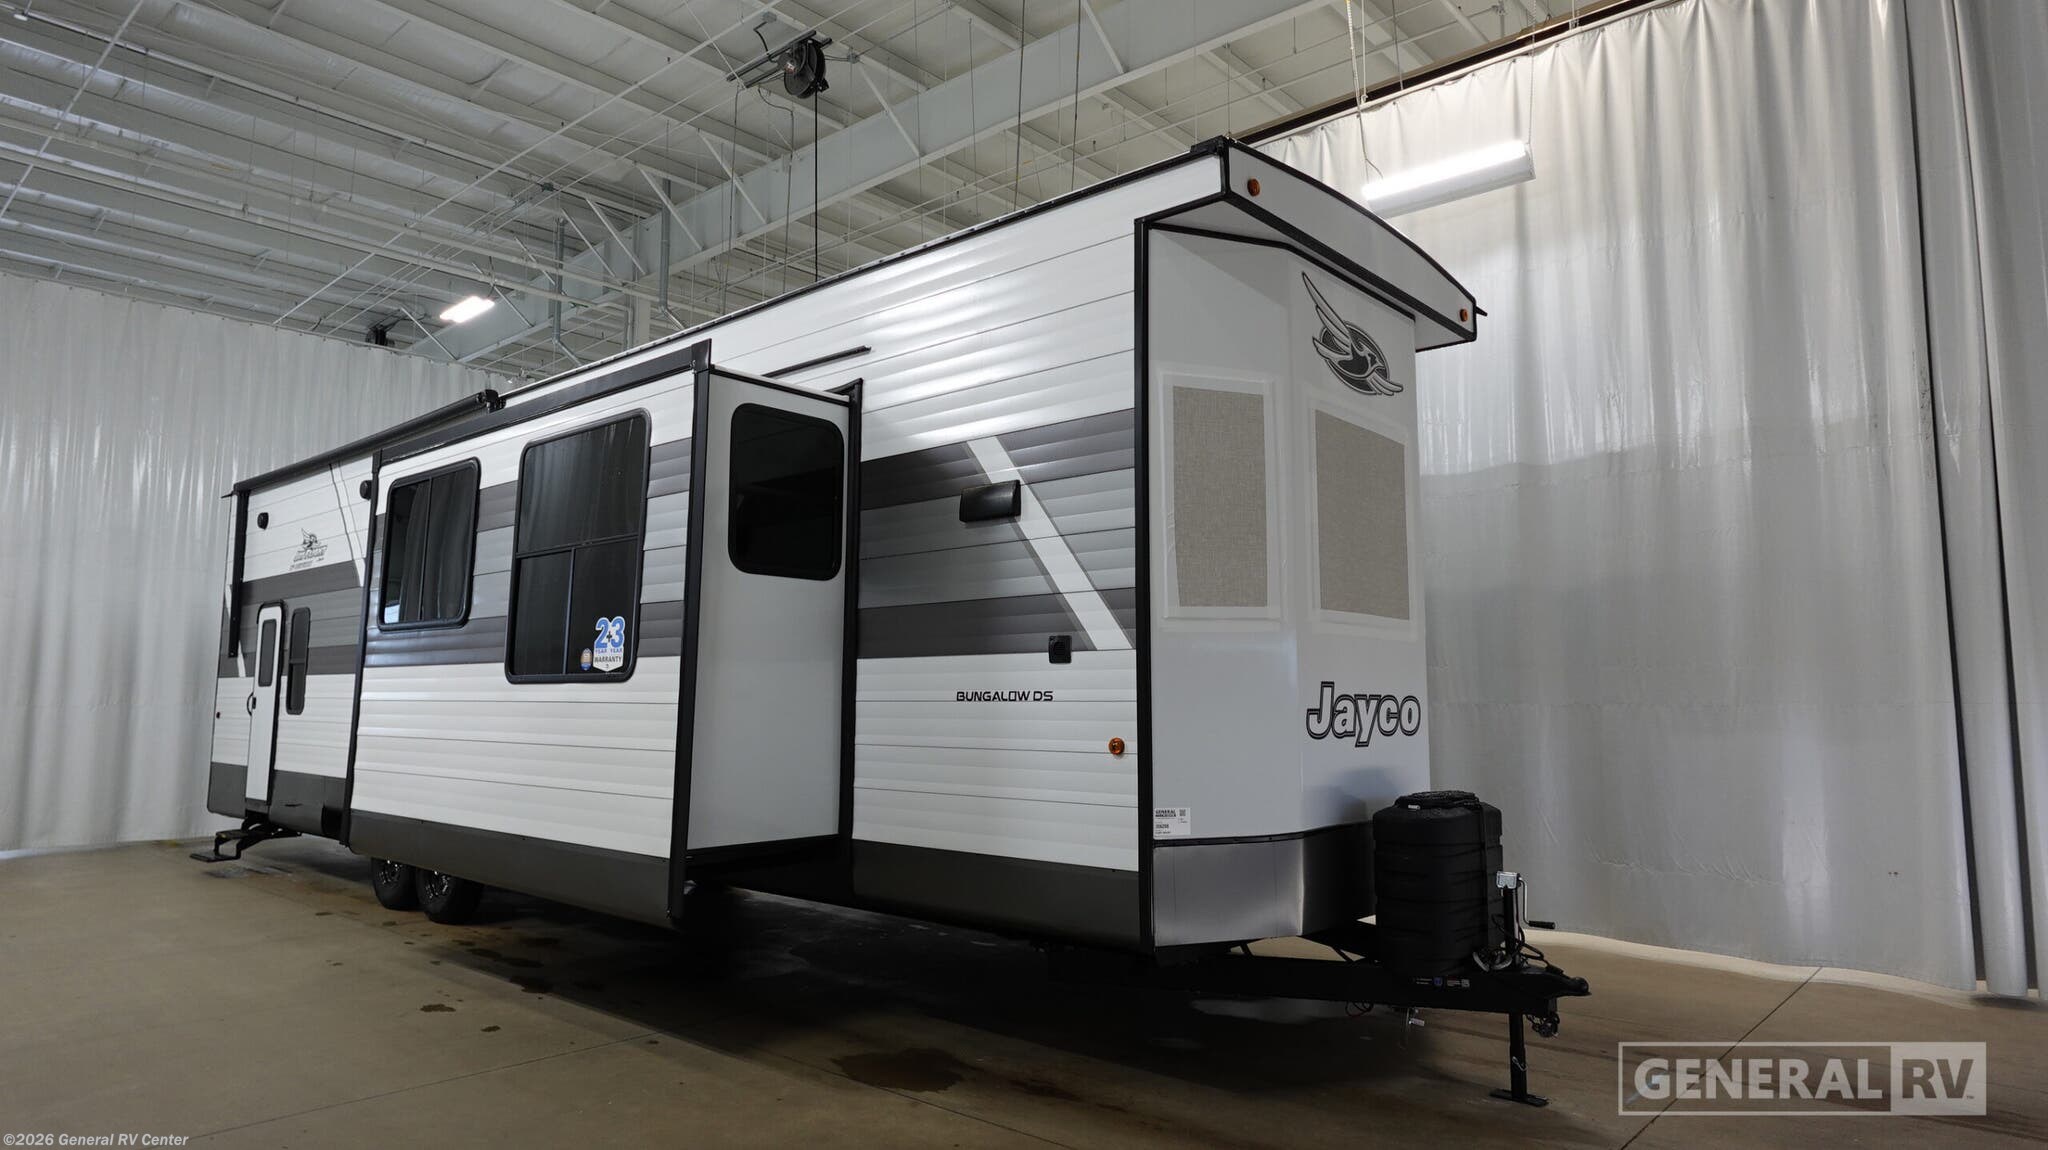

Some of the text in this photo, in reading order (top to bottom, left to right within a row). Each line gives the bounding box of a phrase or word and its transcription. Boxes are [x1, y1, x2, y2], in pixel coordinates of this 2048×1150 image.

[956, 690, 1054, 702] BUNGALOW DS
[1306, 681, 1421, 748] Jayco
